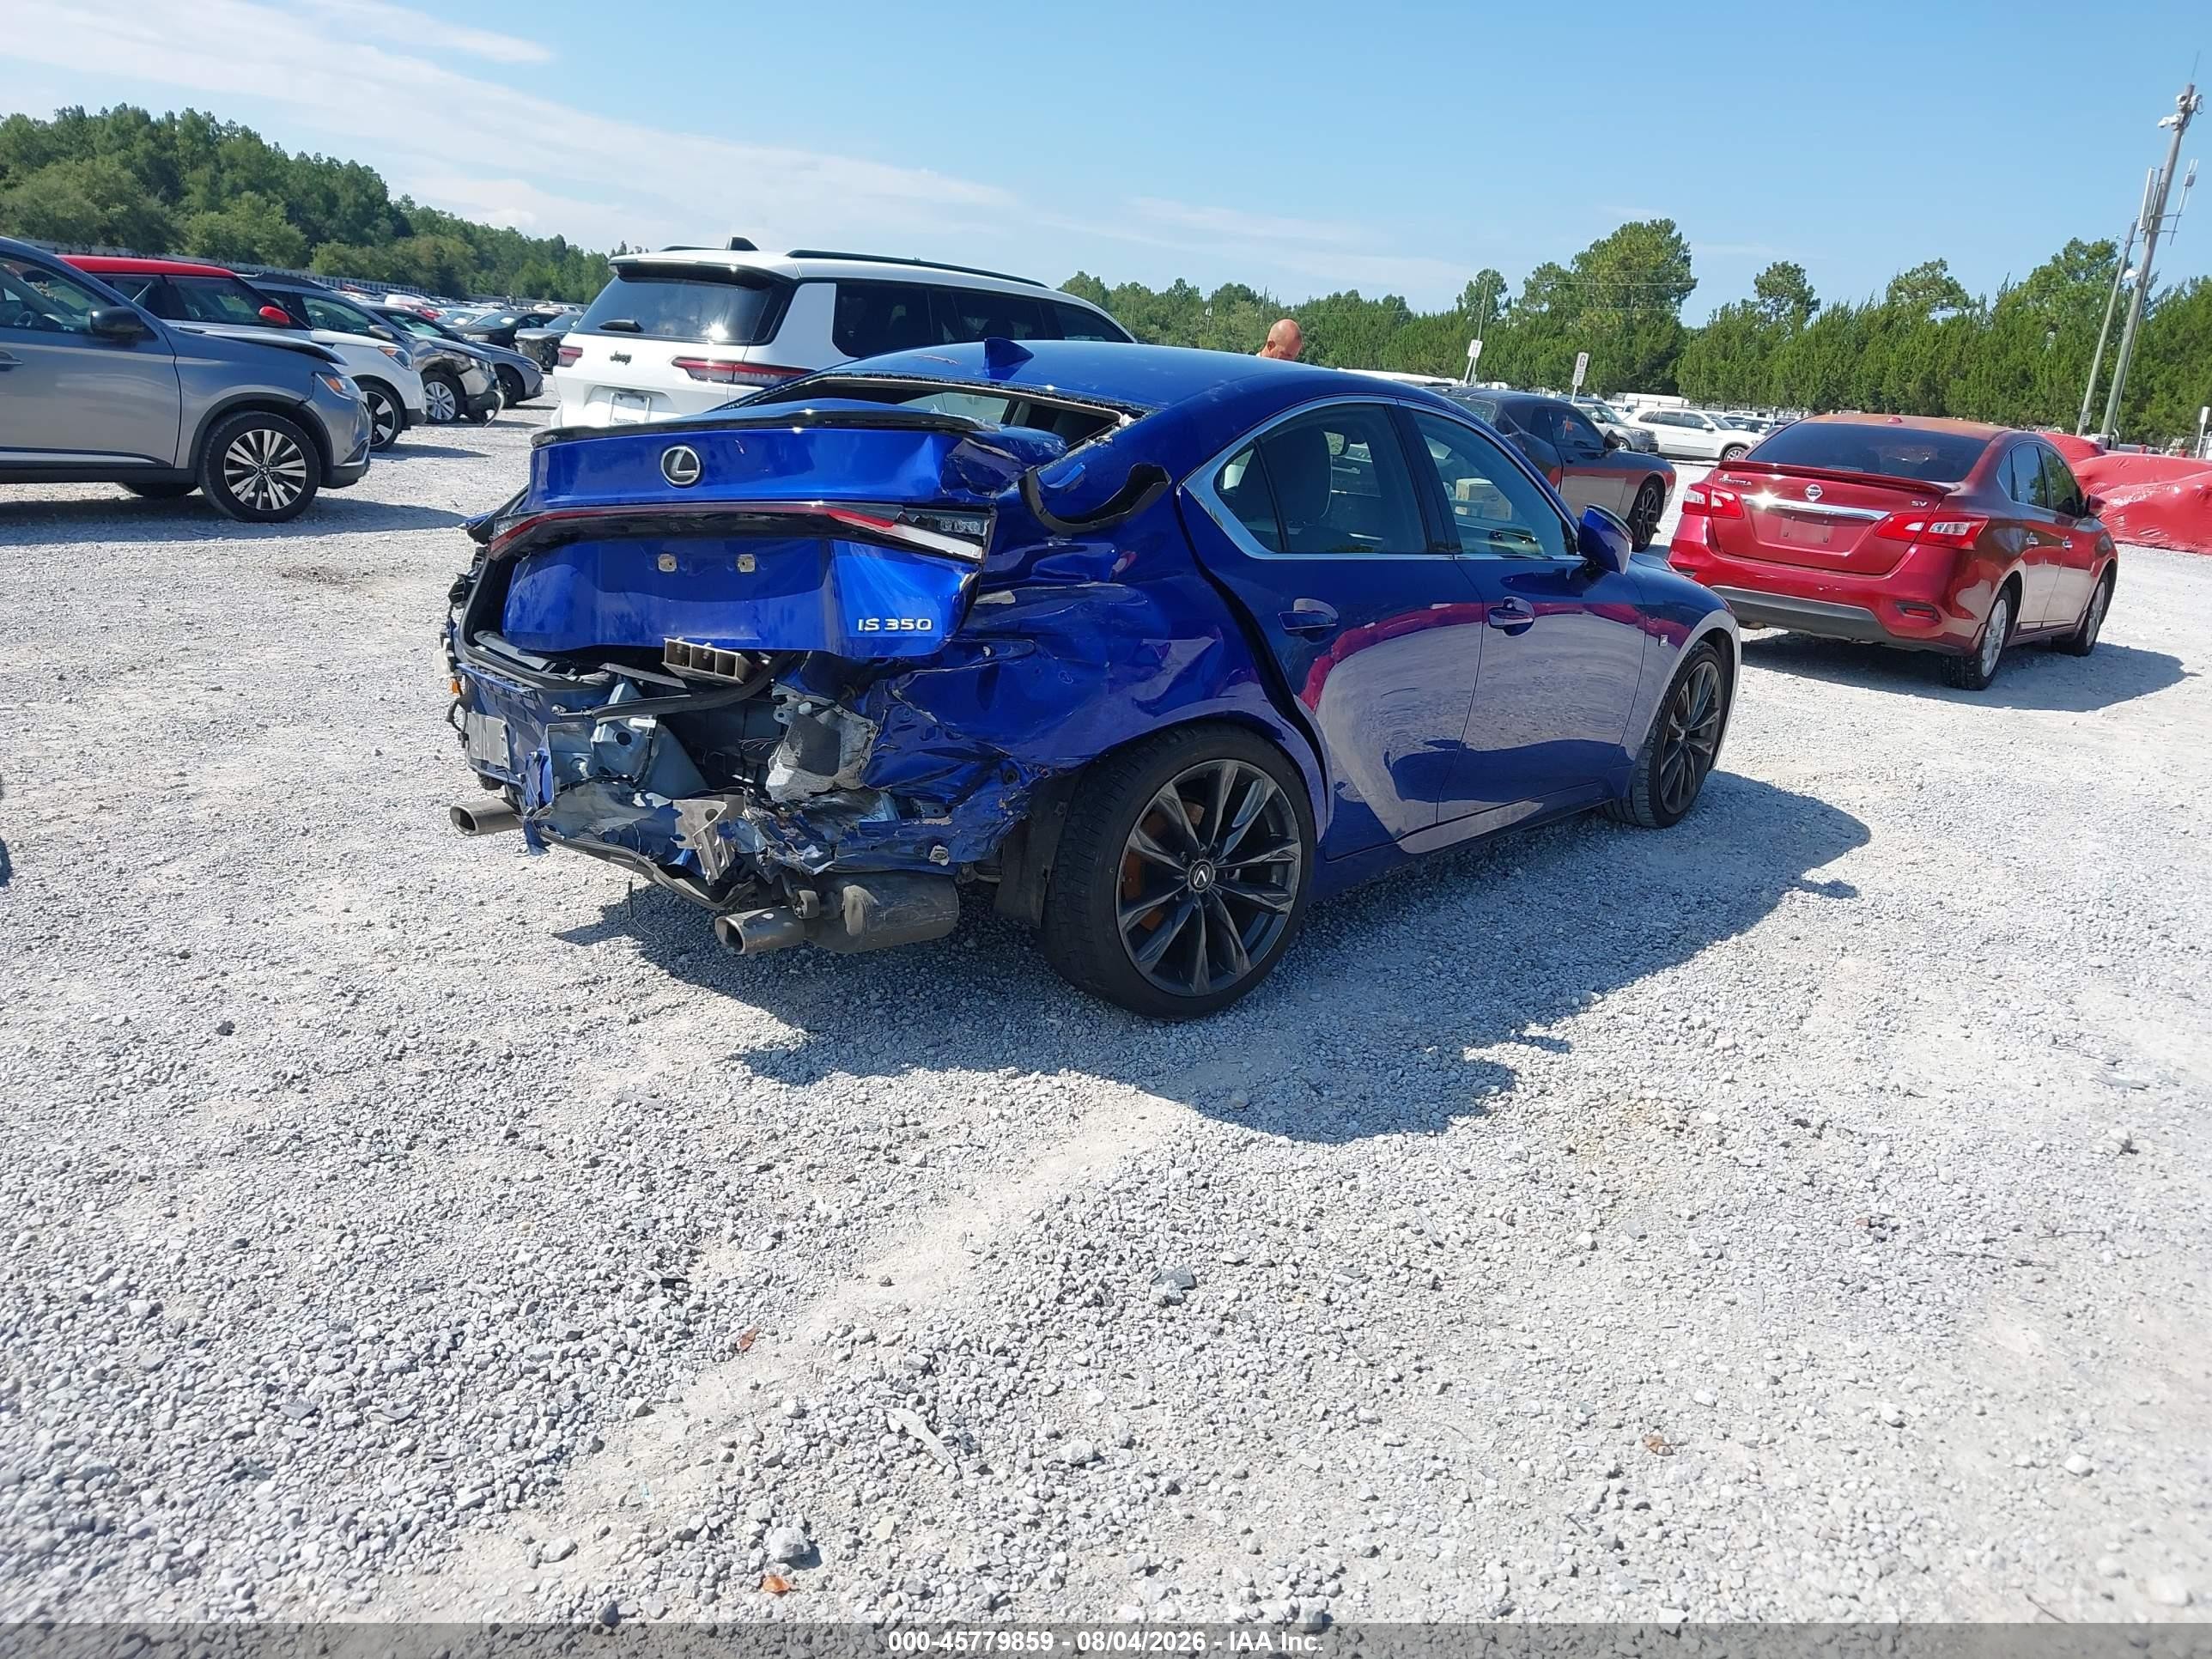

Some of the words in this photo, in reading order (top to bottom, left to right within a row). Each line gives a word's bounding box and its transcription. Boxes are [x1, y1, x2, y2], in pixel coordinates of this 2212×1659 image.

[1578, 355, 1586, 368] G
[858, 617, 880, 631] IS
[884, 617, 933, 631] 350
